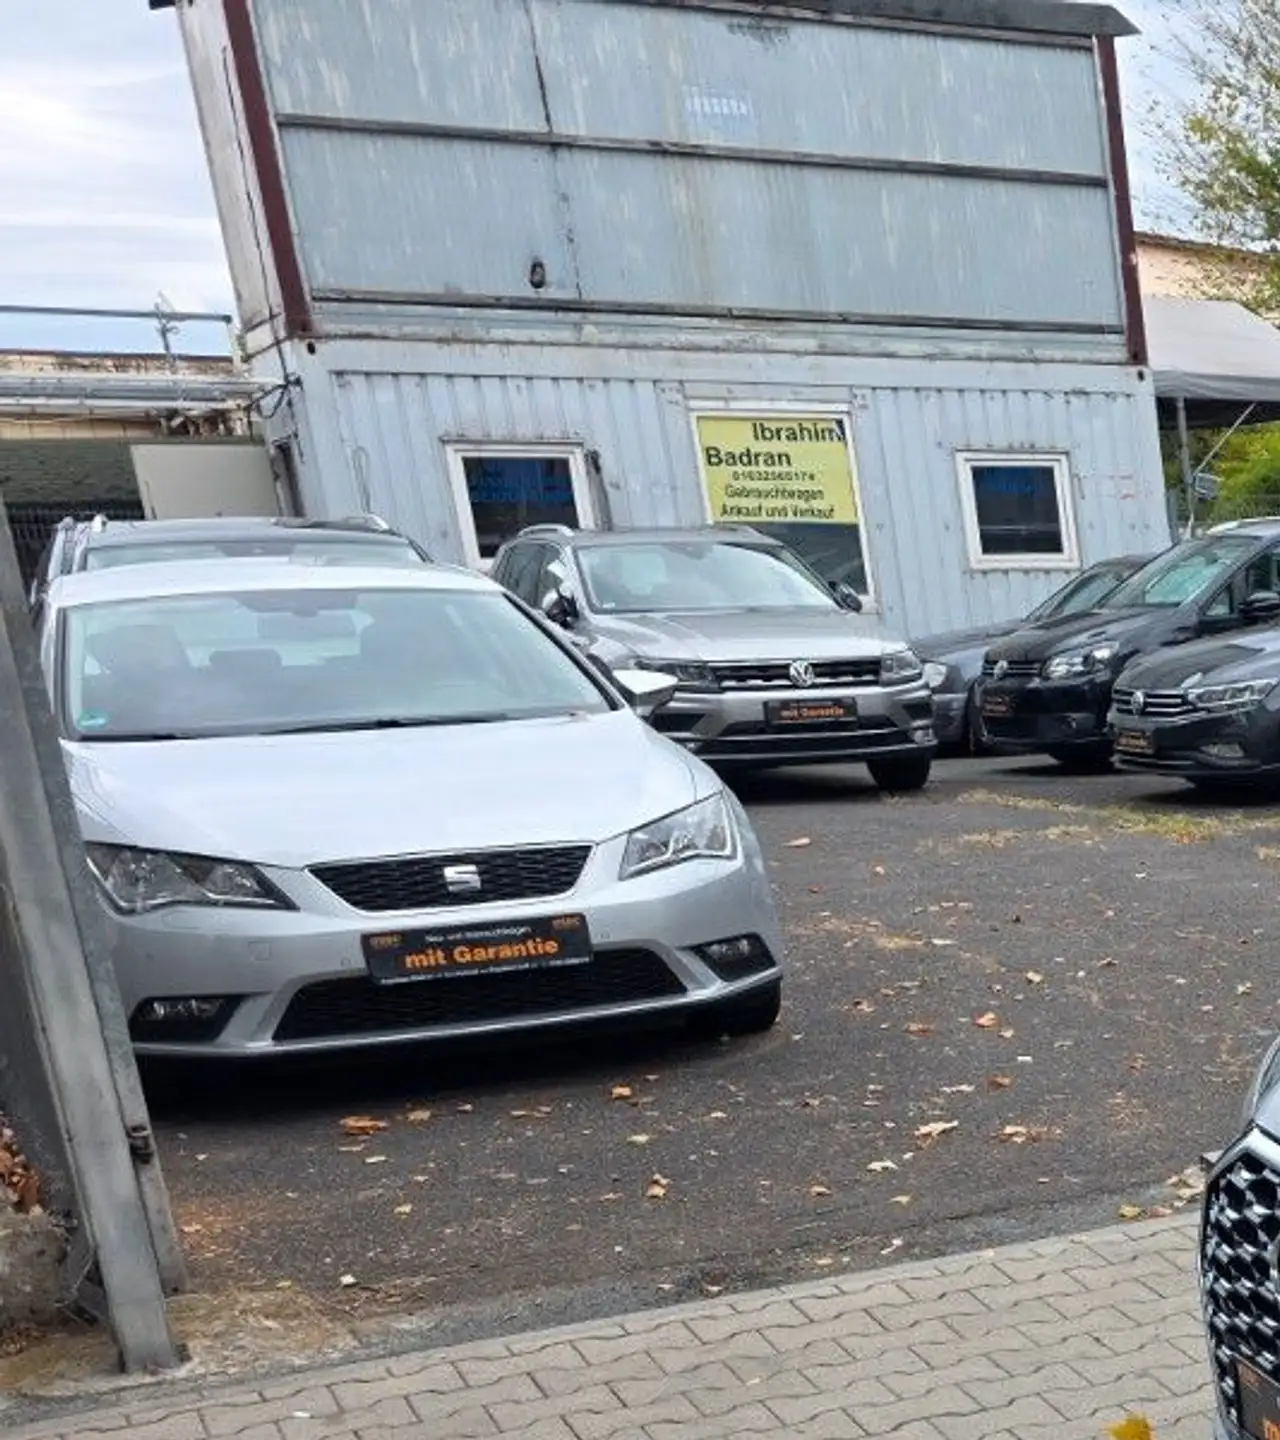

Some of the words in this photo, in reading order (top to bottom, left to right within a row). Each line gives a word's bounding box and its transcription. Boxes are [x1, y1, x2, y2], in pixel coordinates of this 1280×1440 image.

[752, 422, 844, 442] Ibrahim
[705, 447, 792, 467] Badran
[405, 948, 447, 968] mit
[453, 937, 559, 964] Garantie
